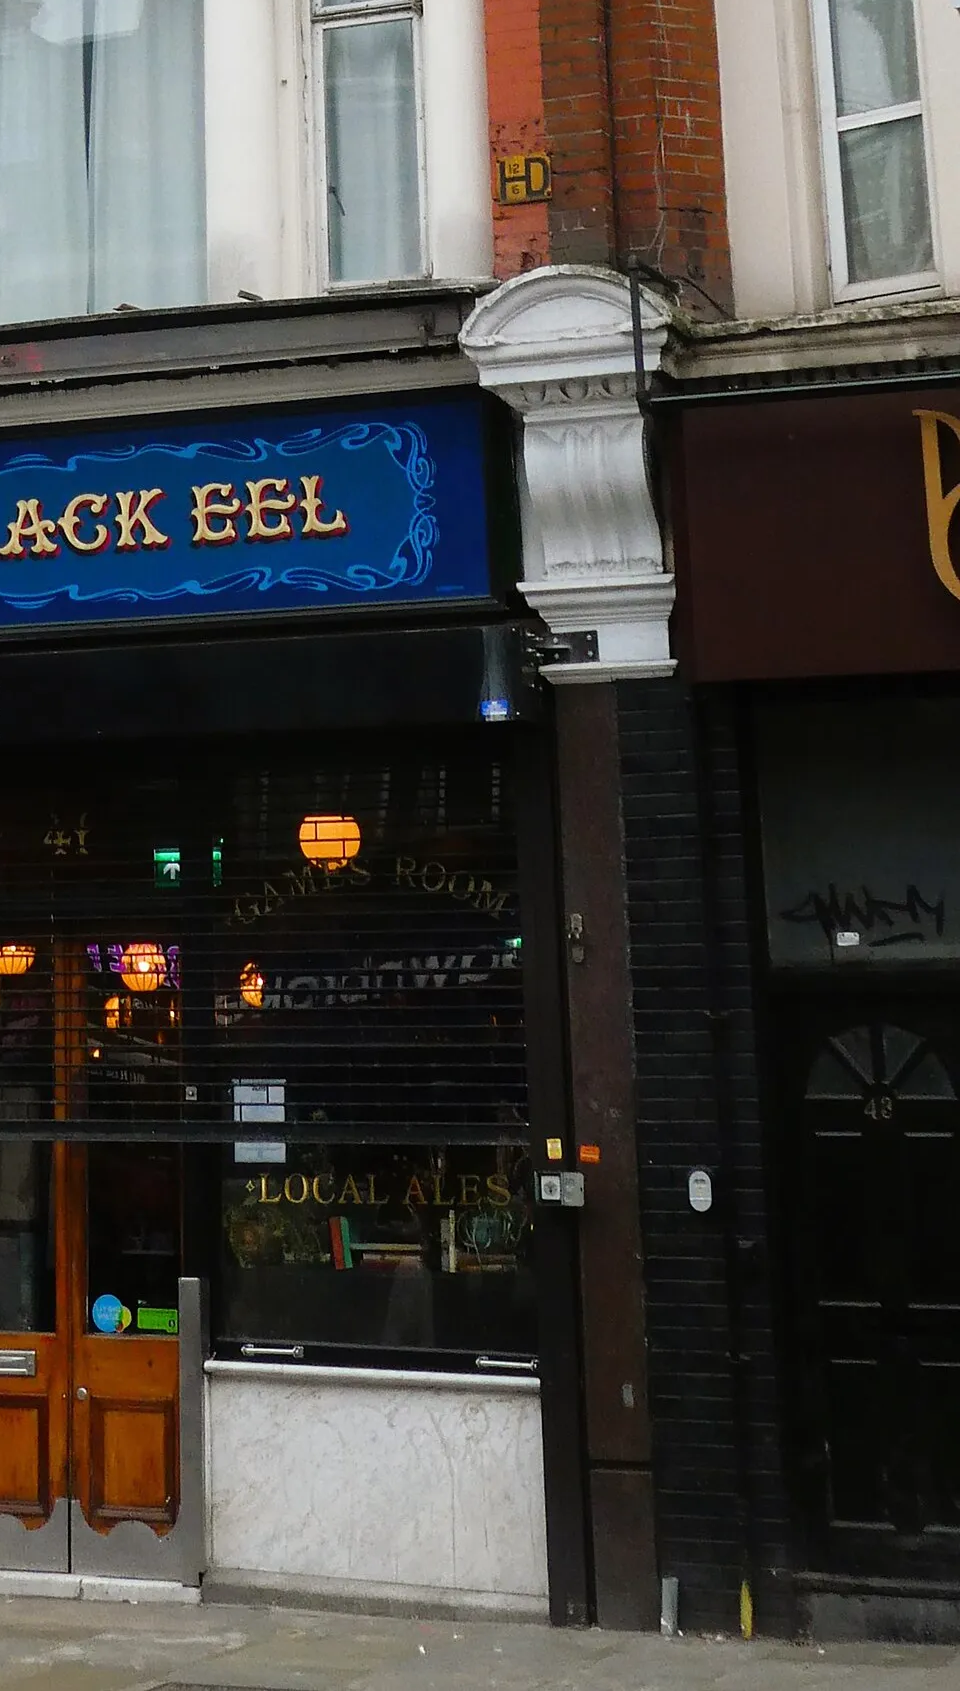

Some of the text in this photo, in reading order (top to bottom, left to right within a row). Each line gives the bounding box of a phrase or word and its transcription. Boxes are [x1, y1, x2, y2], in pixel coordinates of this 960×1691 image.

[508, 163, 520, 175] 12
[512, 185, 521, 196] 6
[190, 474, 350, 545] EEL
[394, 855, 511, 920] ROOM
[257, 1172, 514, 1206] LOCAL ALES
